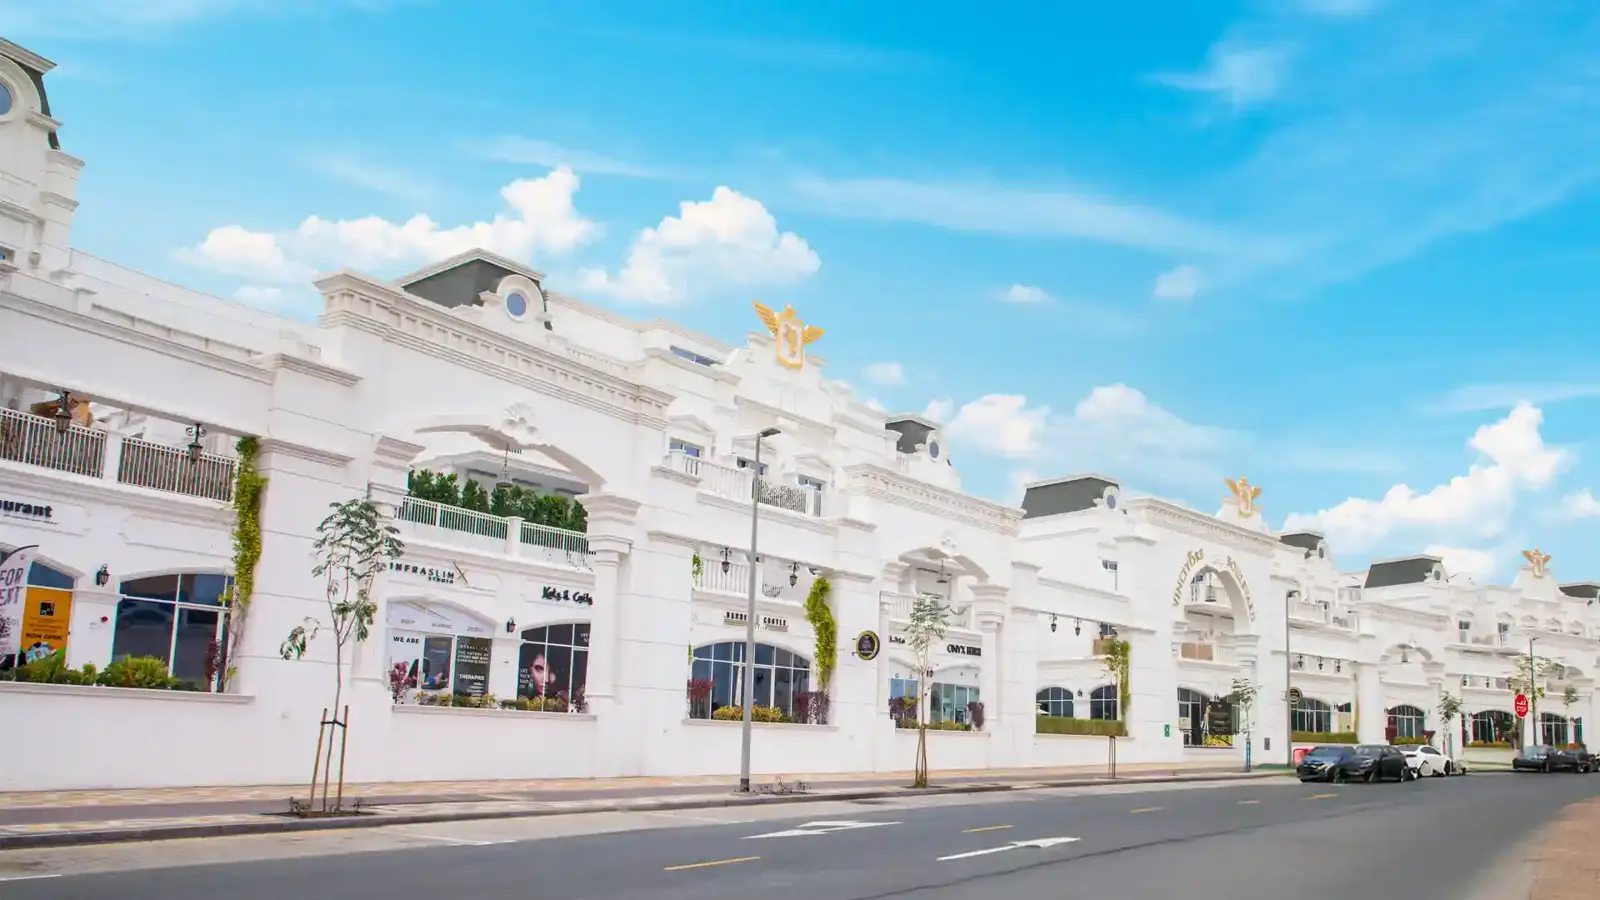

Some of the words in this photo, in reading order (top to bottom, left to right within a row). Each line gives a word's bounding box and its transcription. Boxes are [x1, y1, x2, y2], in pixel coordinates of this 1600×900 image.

[0, 500, 53, 517] urant
[0, 568, 24, 586] FOR
[389, 562, 454, 579] INFRASLIM
[726, 612, 749, 621] BARBE
